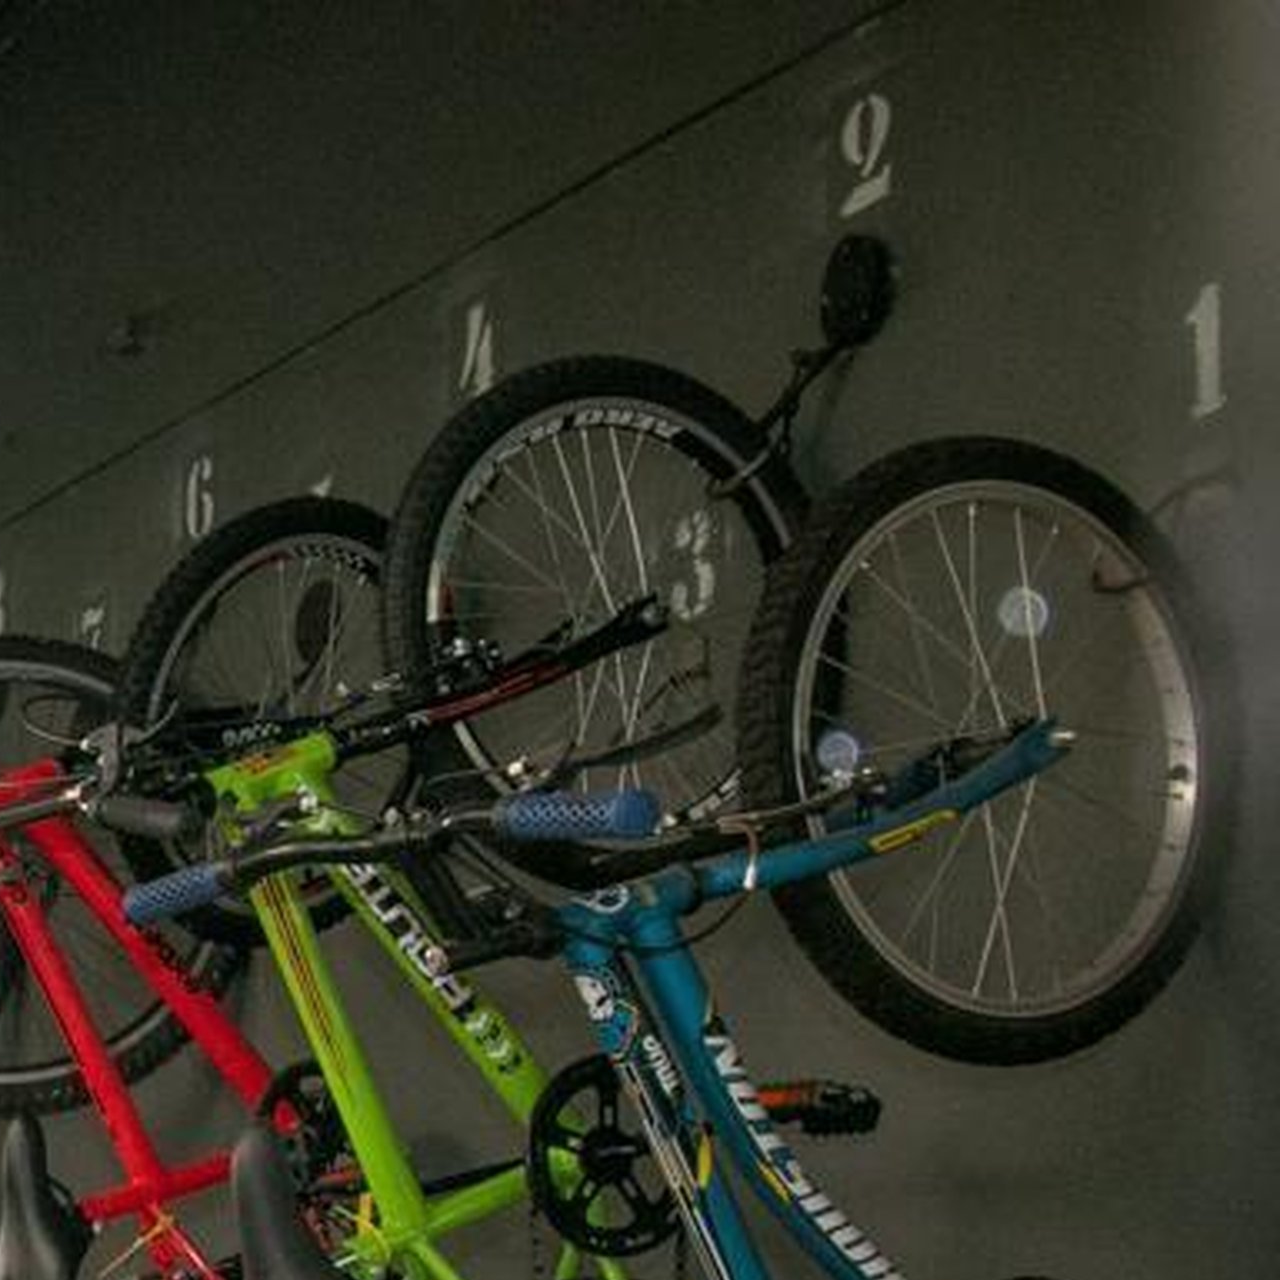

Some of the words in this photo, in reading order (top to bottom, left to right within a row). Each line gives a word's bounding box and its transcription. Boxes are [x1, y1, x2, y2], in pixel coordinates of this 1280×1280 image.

[841, 94, 892, 218] 2
[1184, 283, 1227, 418] 1
[187, 456, 214, 538] 6
[671, 509, 716, 621] 3
